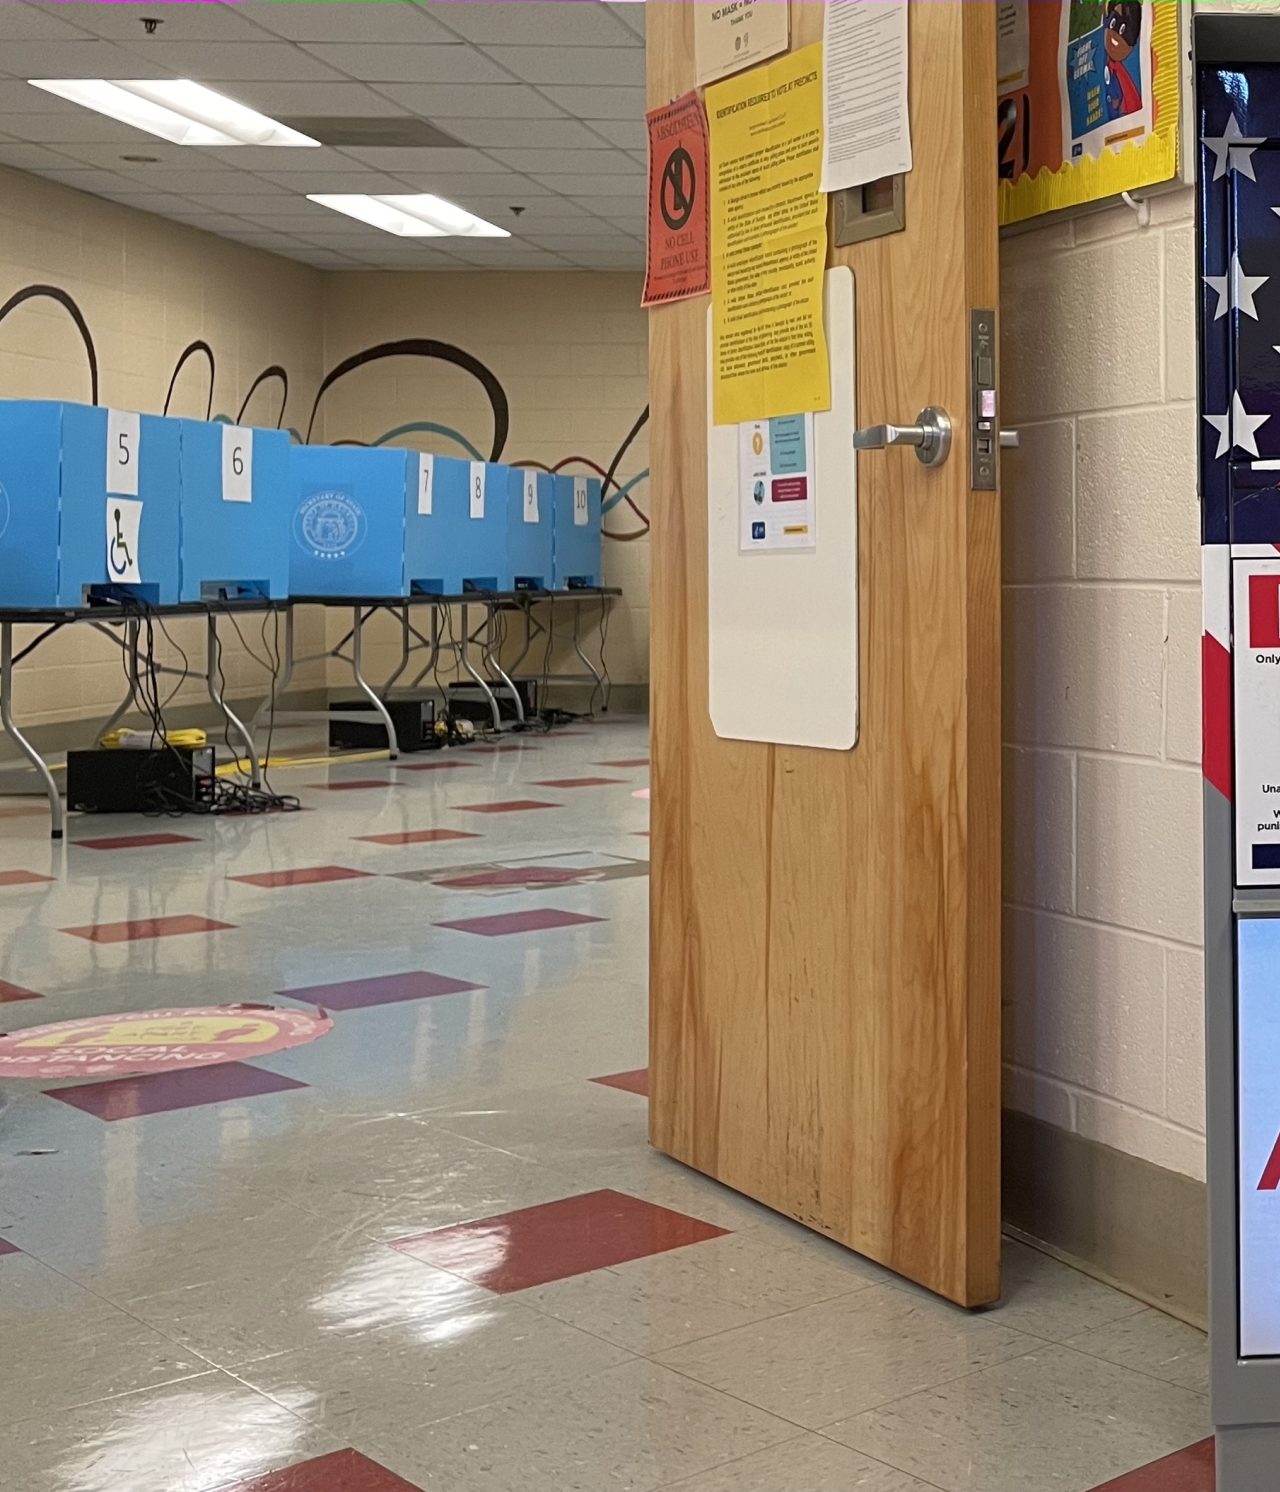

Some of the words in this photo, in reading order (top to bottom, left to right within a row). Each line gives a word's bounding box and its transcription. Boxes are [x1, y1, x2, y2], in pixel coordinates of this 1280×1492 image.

[665, 236, 676, 249] NO
[118, 433, 129, 466] 5
[233, 447, 244, 475] 6
[423, 469, 429, 493] 7
[475, 476, 481, 499] 8
[528, 484, 533, 505] 9
[577, 490, 586, 509] 10
[1255, 654, 1280, 664] Only
